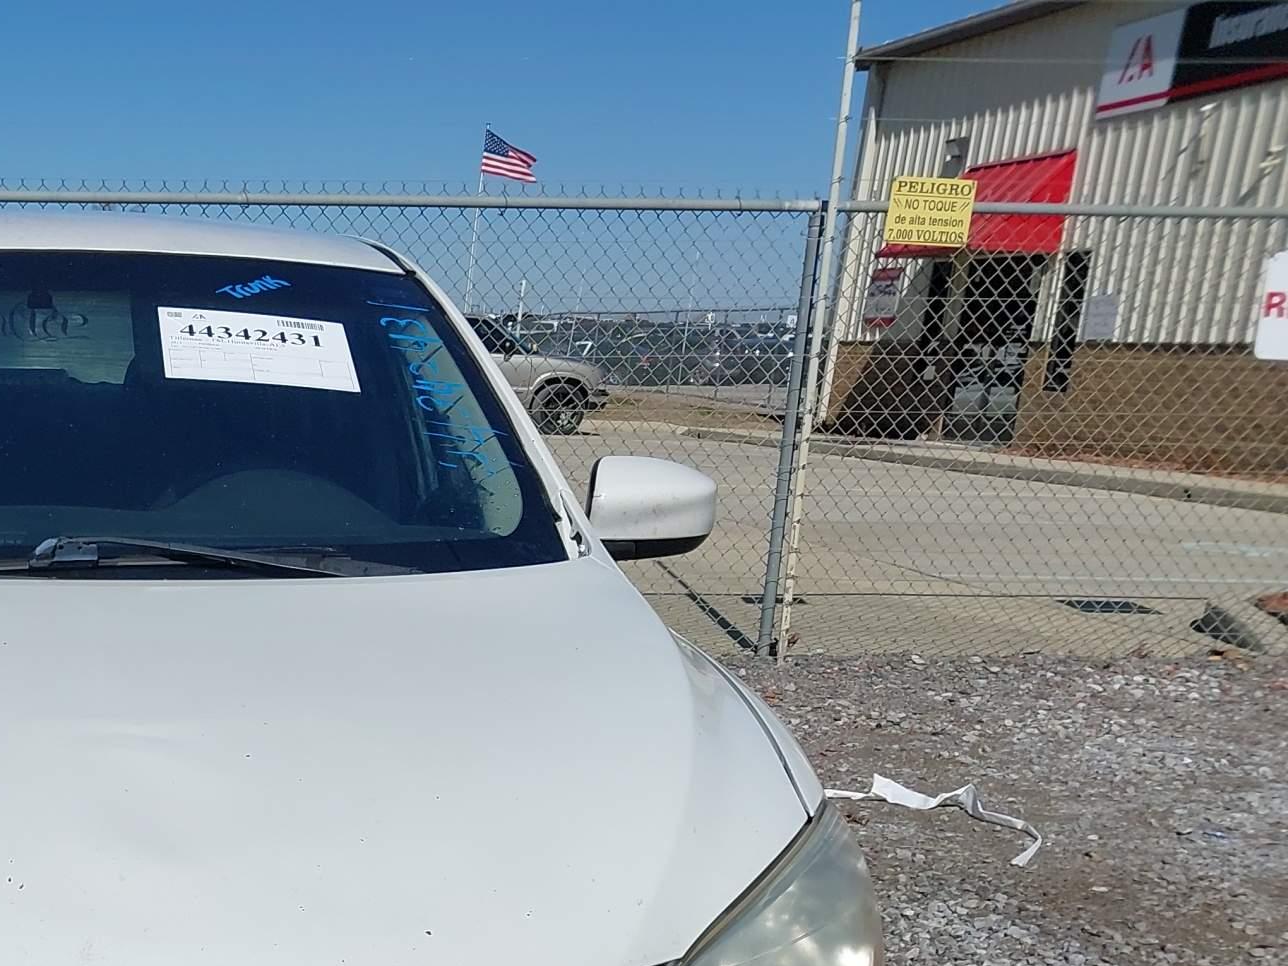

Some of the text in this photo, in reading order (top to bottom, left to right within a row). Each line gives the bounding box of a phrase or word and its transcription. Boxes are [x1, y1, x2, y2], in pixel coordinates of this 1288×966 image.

[896, 180, 972, 197] PELIGRO
[904, 199, 958, 212] NO TOQUE
[894, 214, 964, 228] de alta tension
[916, 229, 964, 243] VOLTIOS
[179, 324, 324, 348] 44342431
